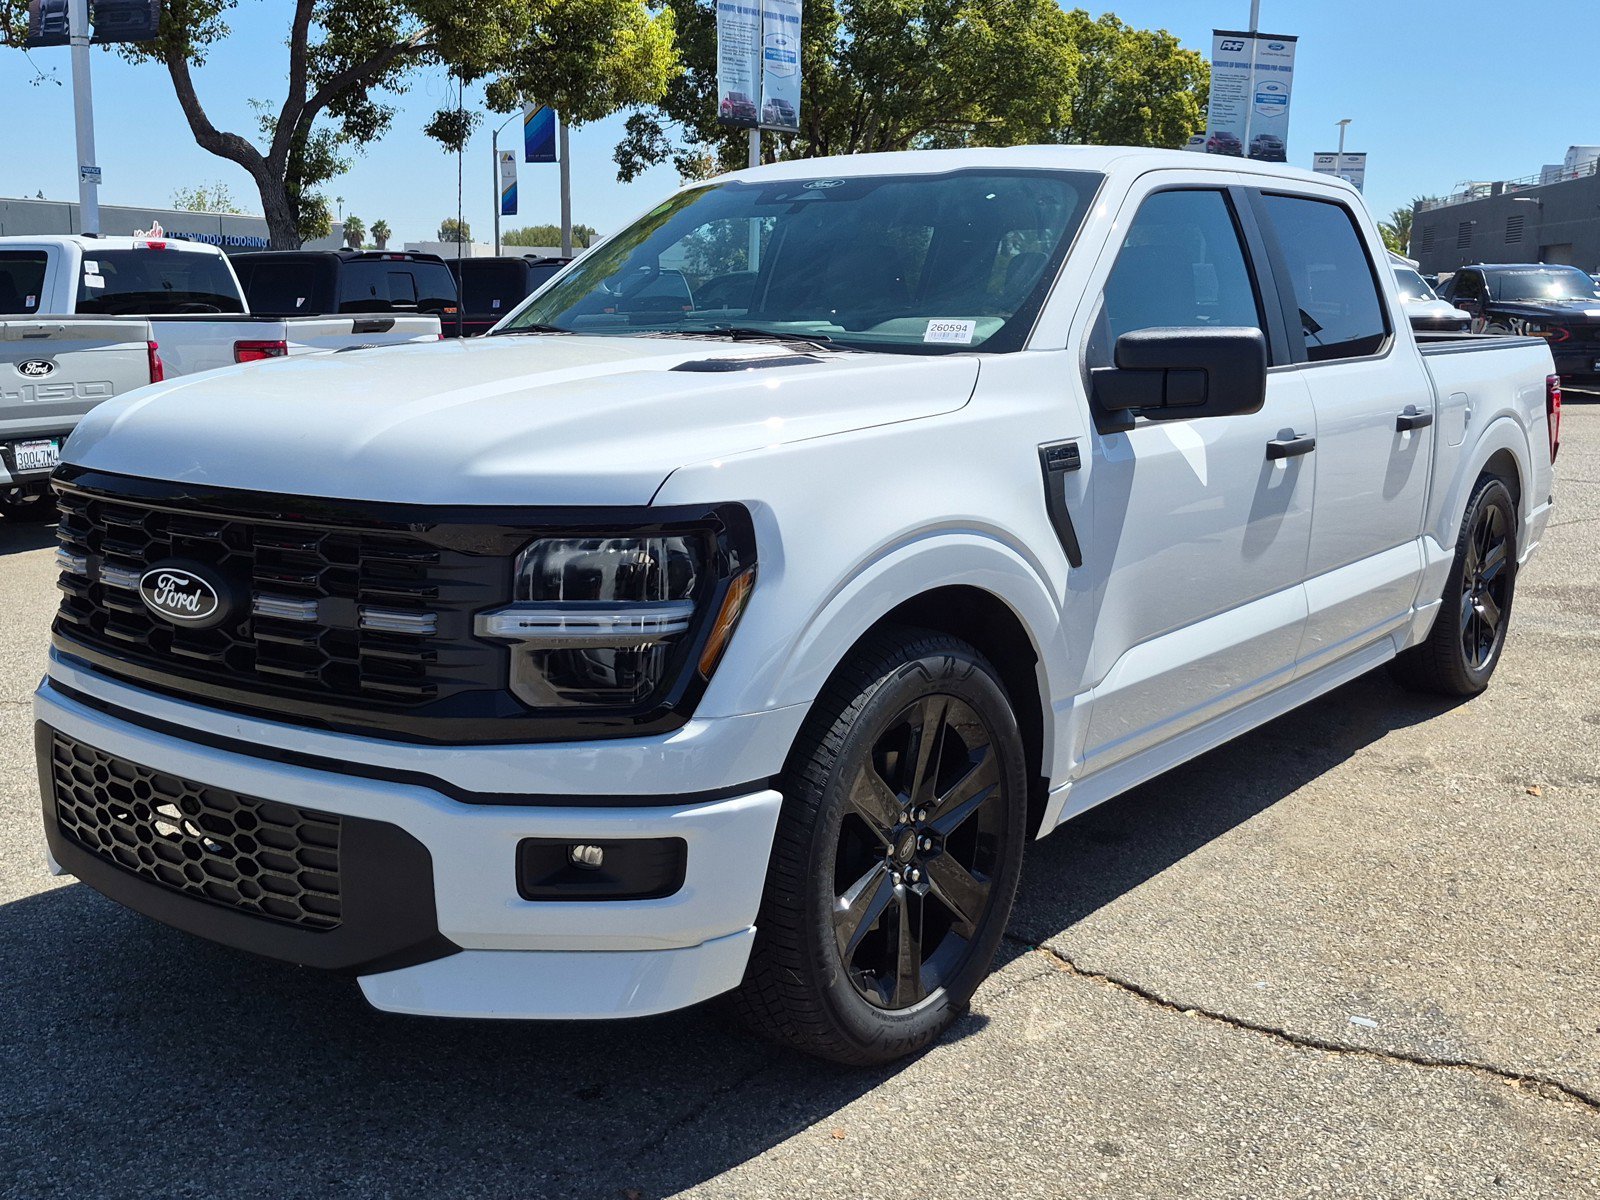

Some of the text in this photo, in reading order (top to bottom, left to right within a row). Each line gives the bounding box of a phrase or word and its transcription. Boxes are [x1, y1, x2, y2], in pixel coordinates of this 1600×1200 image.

[225, 235, 267, 248] FLOORING
[930, 324, 968, 332] 260594
[0, 380, 114, 402] -150
[17, 450, 59, 465] 30047M4
[154, 573, 202, 612] Ford
